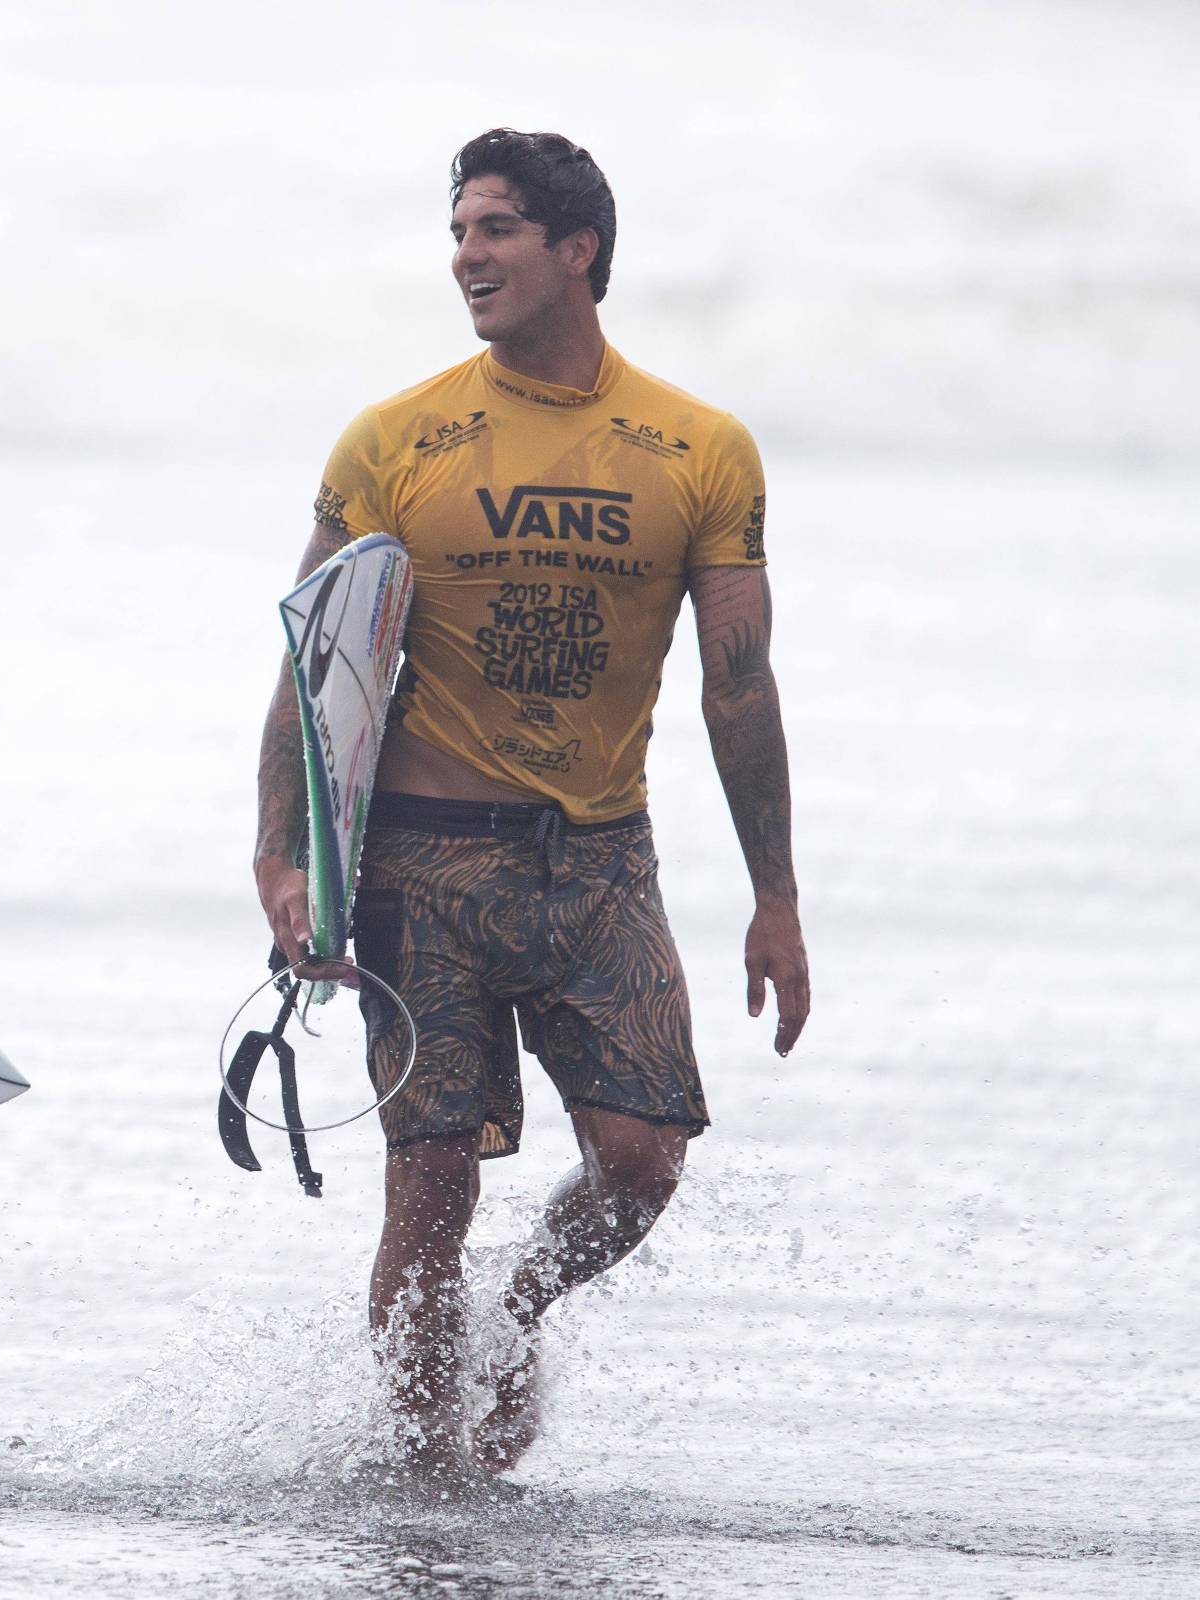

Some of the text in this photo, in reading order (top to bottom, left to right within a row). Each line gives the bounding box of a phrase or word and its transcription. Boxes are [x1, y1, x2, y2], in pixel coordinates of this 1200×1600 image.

[437, 420, 464, 441] ISA
[637, 423, 664, 442] ISA
[476, 485, 632, 545] VANS
[518, 550, 569, 567] THE
[500, 582, 597, 610] 2019 ISA
[484, 657, 593, 700] GAMES
